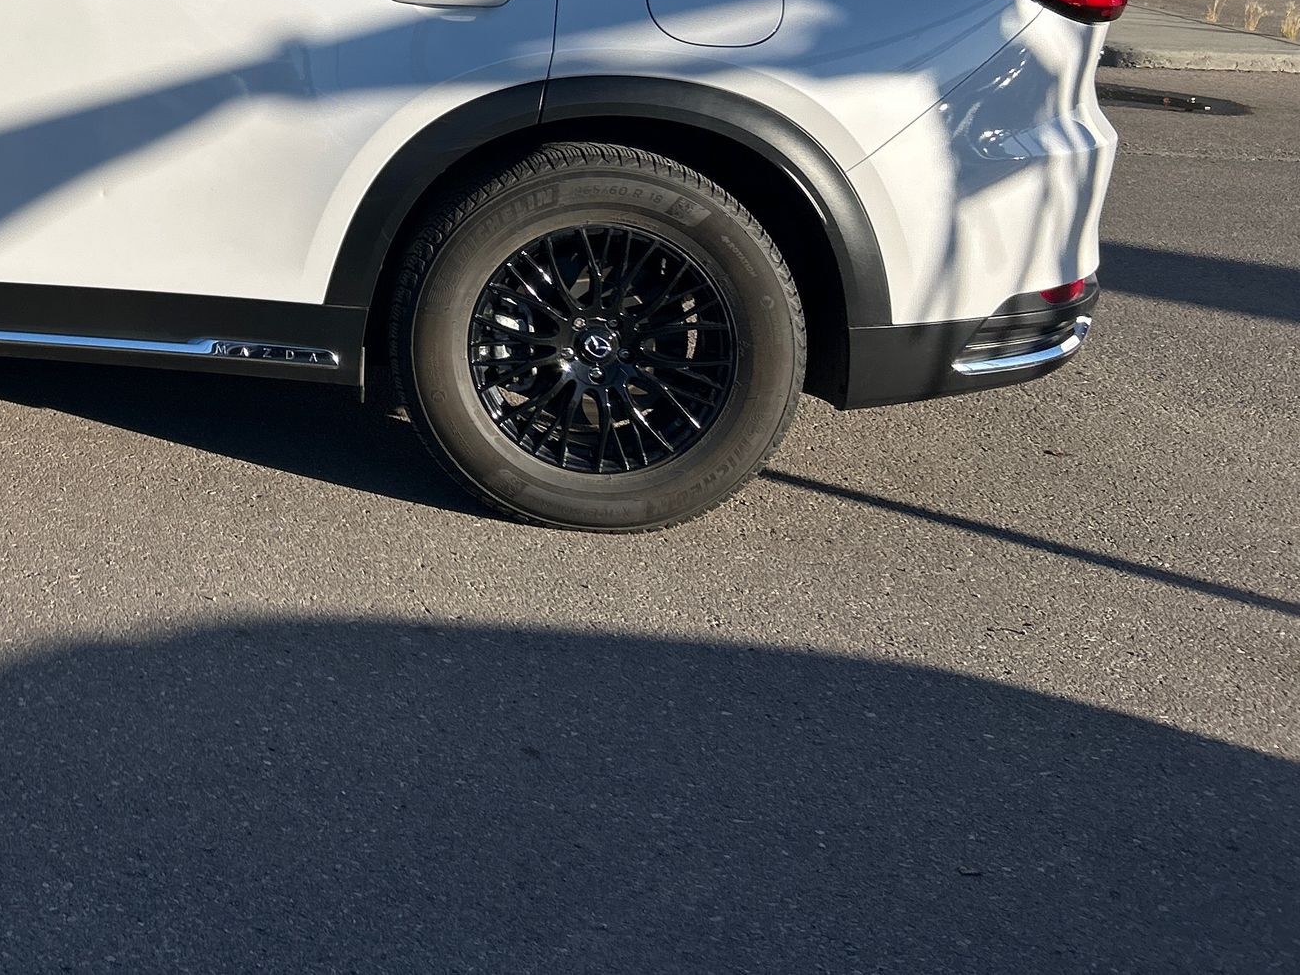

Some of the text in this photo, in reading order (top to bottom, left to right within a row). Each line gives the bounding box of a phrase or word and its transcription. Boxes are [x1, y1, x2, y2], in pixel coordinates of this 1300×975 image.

[633, 188, 644, 199] R
[649, 192, 664, 204] 18
[450, 184, 557, 269] MICHELIN
[212, 342, 319, 364] MAZDA
